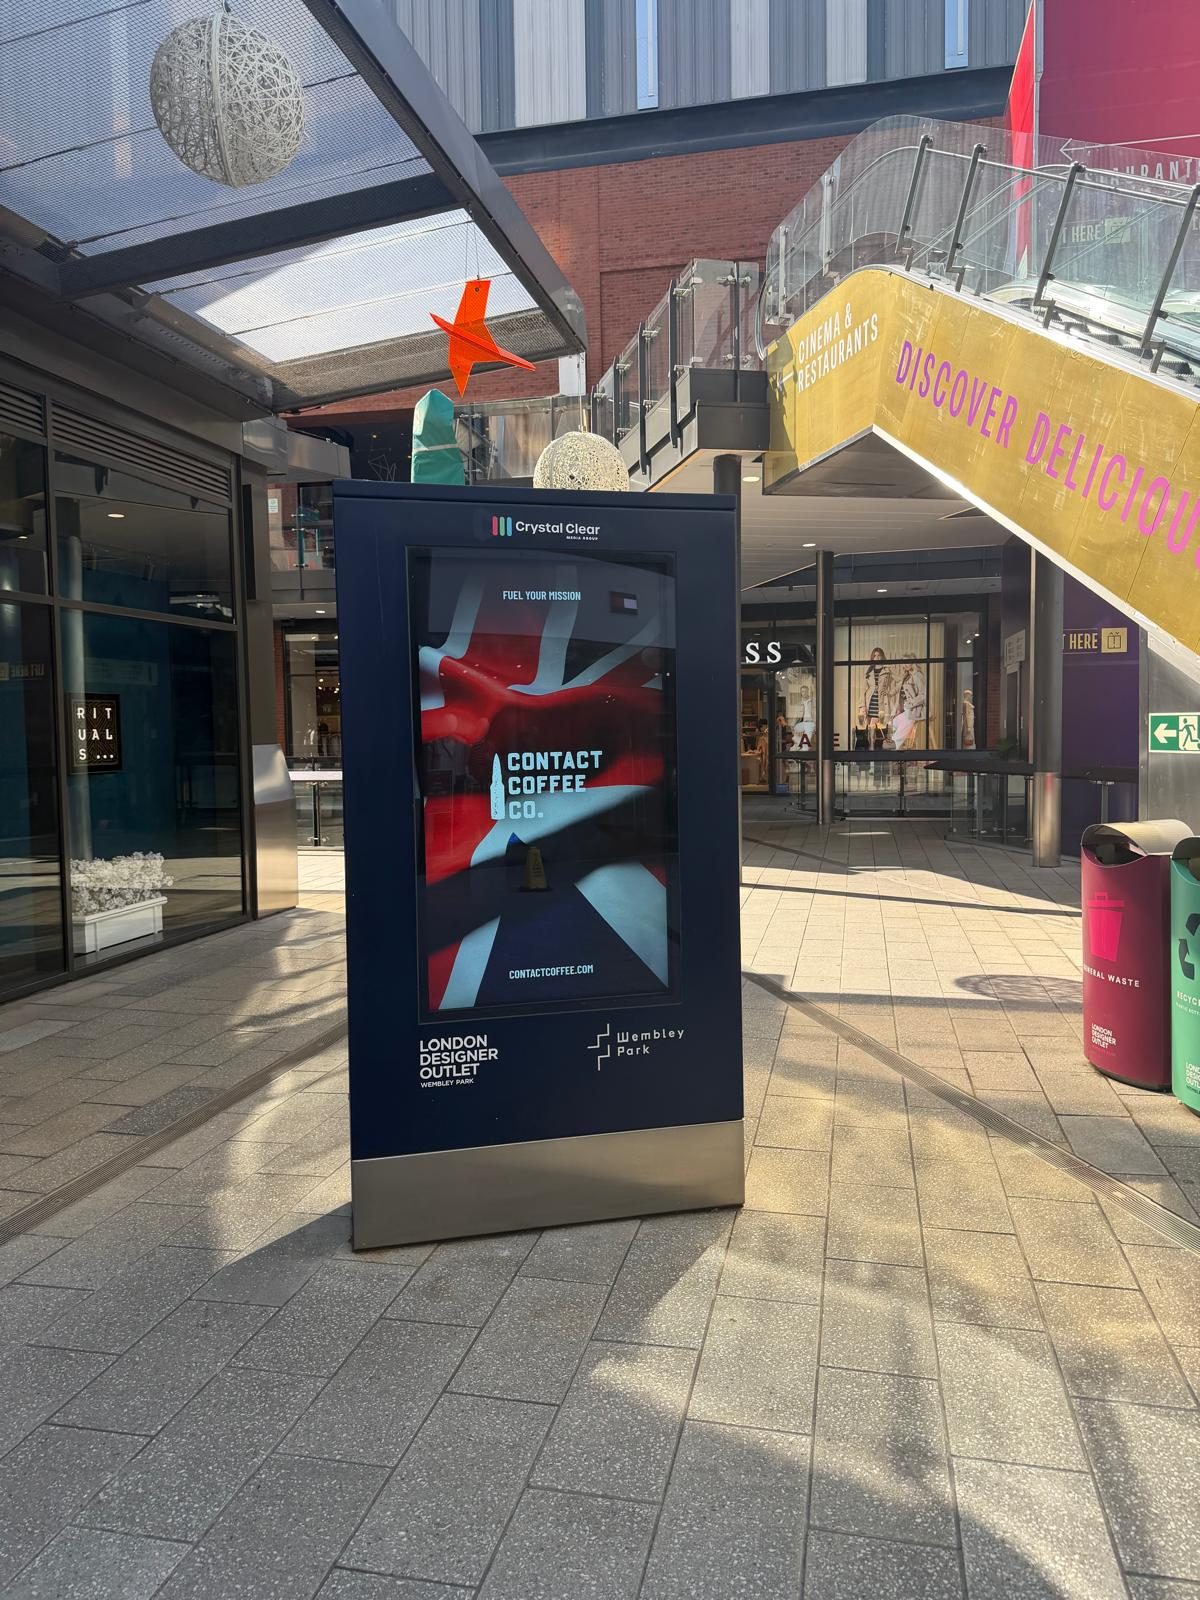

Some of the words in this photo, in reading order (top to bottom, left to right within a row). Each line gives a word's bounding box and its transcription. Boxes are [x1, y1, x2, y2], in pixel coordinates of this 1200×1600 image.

[798, 311, 841, 365] CINEMA
[844, 302, 852, 330] &
[797, 313, 879, 394] RESTAURANTS
[895, 340, 1019, 449] DISCOVER
[1025, 411, 1200, 571] DELICIOU
[515, 521, 563, 535] Crystal
[565, 523, 601, 535] Clear
[502, 590, 524, 601] FUEL
[525, 590, 547, 601] YOUR
[548, 591, 581, 601] MISSION
[1069, 632, 1098, 649] HERE
[507, 750, 603, 771] CONTACT
[508, 774, 586, 795] COFFEE
[509, 800, 544, 820] CO.
[508, 964, 594, 980] CONTACTCOFFEE.COM
[1107, 973, 1141, 988] WASTE
[1176, 990, 1200, 1007] RECYC
[617, 1028, 684, 1043] Wembley
[1091, 1023, 1112, 1037] LONDON
[1091, 1029, 1117, 1046] DESIGNER
[419, 1034, 488, 1053] LONDON
[617, 1044, 650, 1057] Park
[1091, 1036, 1109, 1049] OUTLET
[419, 1048, 499, 1066] DESIGNER
[419, 1063, 480, 1079] OUTLET
[420, 1080, 454, 1088] WEMBLEY
[455, 1078, 474, 1086] PARK
